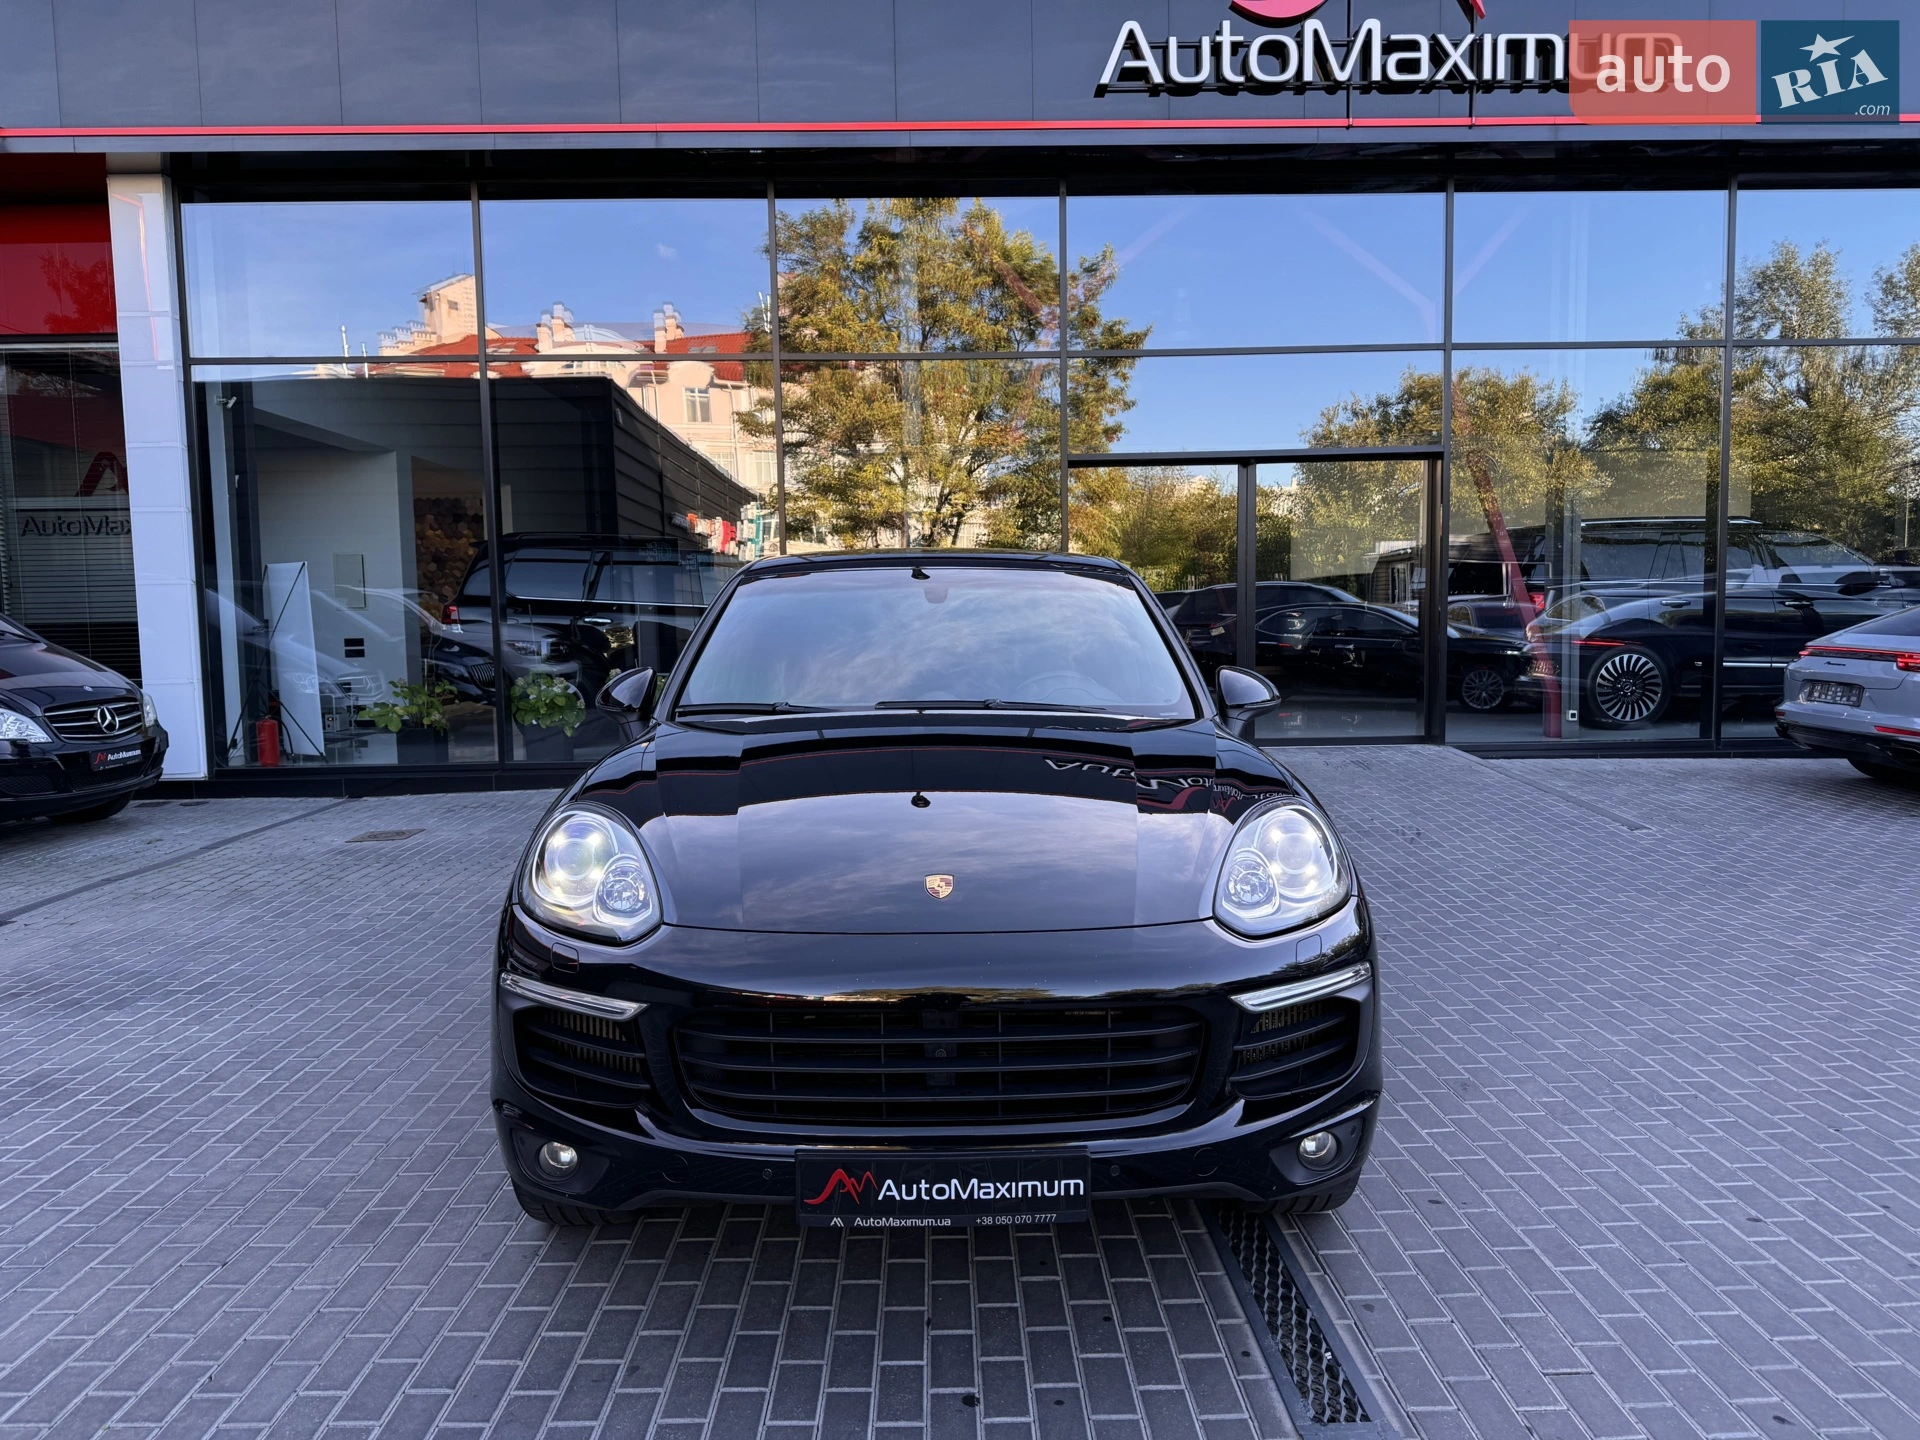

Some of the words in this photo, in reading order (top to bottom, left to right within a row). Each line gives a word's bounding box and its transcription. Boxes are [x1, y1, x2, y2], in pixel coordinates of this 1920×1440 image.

[1099, 18, 1682, 84] AutoMaximum
[878, 1178, 1084, 1201] AutoMaximum
[854, 1216, 951, 1228] AutoMaximum.ua
[975, 1216, 993, 1225] +38
[995, 1215, 1013, 1225] 050
[1015, 1215, 1032, 1224] 070
[1034, 1214, 1057, 1223] 7777
